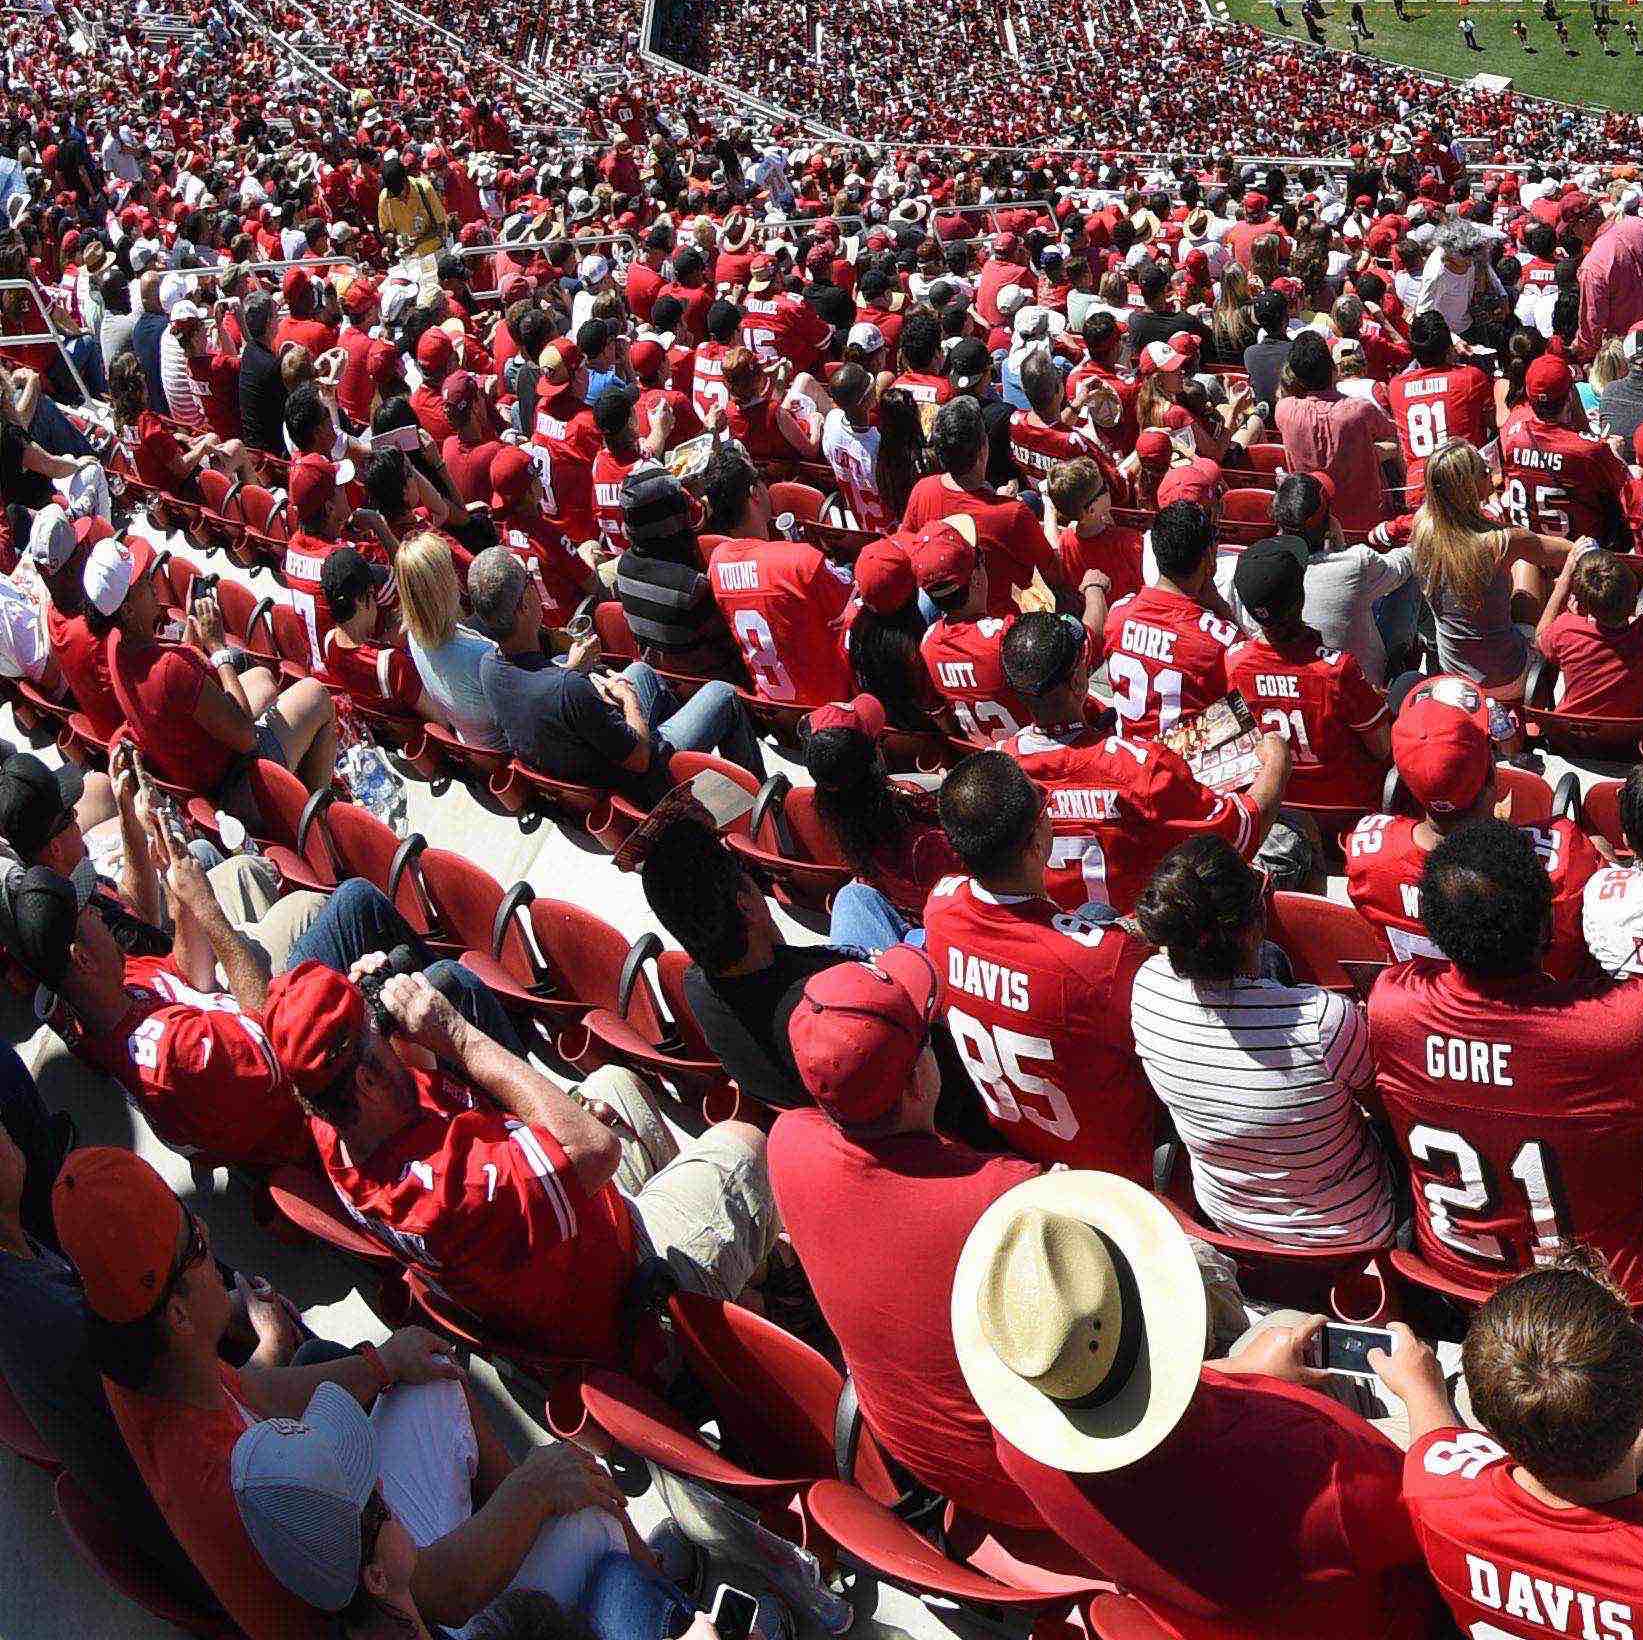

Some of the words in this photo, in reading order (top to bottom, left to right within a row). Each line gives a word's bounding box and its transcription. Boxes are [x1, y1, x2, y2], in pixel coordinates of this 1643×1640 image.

[1407, 401, 1449, 458] 81
[1508, 476, 1571, 537] 85
[718, 560, 760, 591] YOUNG
[1122, 620, 1178, 663] GORE
[937, 662, 978, 688] LOTT
[1106, 656, 1183, 740] 21
[1255, 674, 1300, 700] GORE
[948, 946, 1031, 1013] DAVIS
[947, 1005, 1079, 1143] 85
[1426, 1034, 1514, 1088] GORE
[1408, 1124, 1561, 1265] 21
[1465, 1553, 1634, 1640] DAVIS
